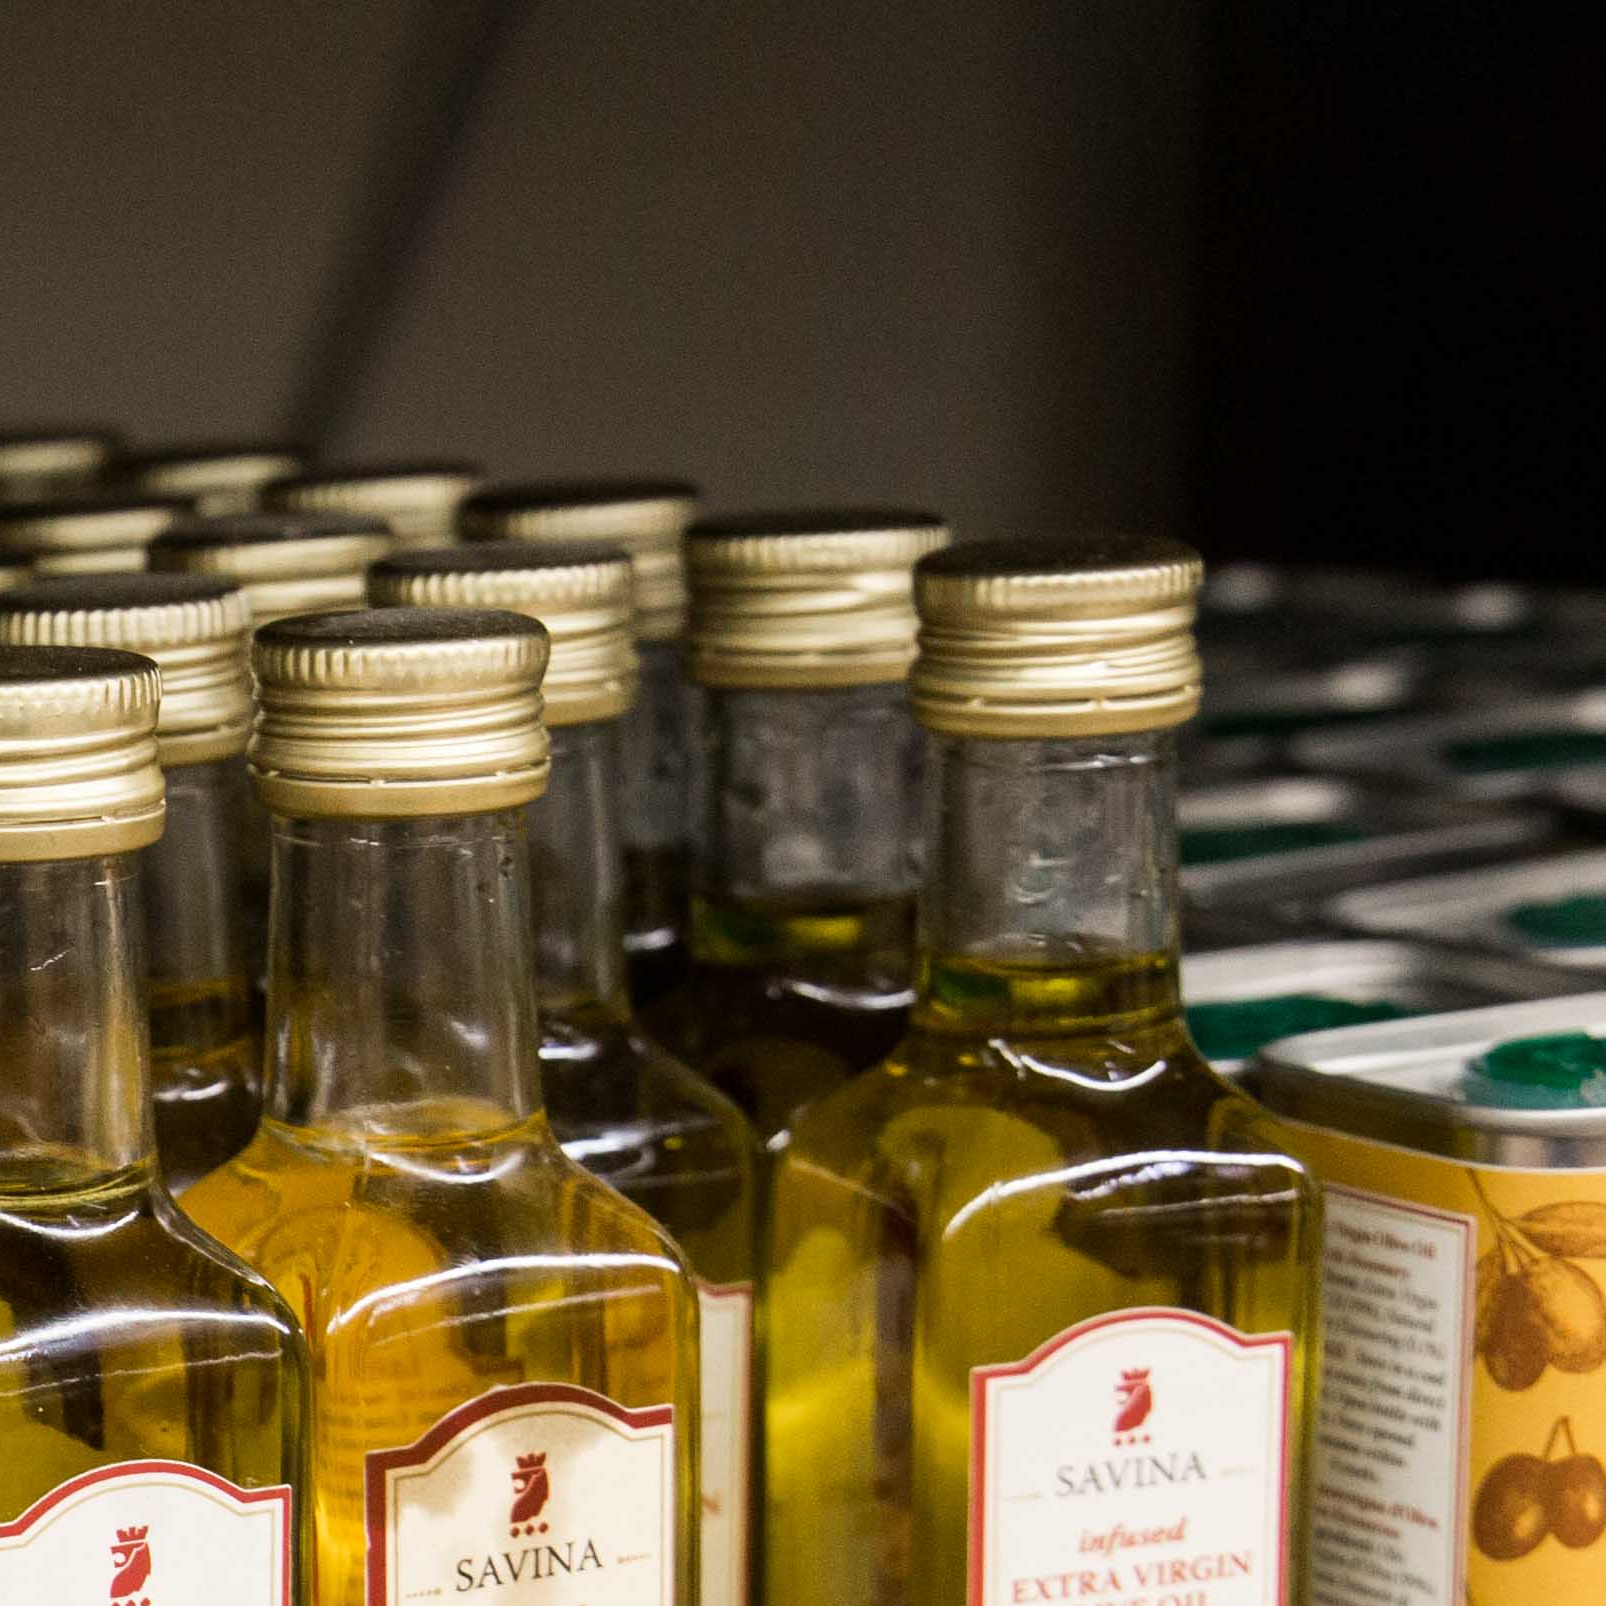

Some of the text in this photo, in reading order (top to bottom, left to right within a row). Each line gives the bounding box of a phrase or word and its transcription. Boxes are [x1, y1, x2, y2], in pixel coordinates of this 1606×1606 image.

[1055, 1451, 1208, 1498] SAVINA
[1078, 1516, 1188, 1556] infused
[455, 1538, 604, 1592] SAVINA
[1012, 1551, 1253, 1605] EXTRA VIRGIN
